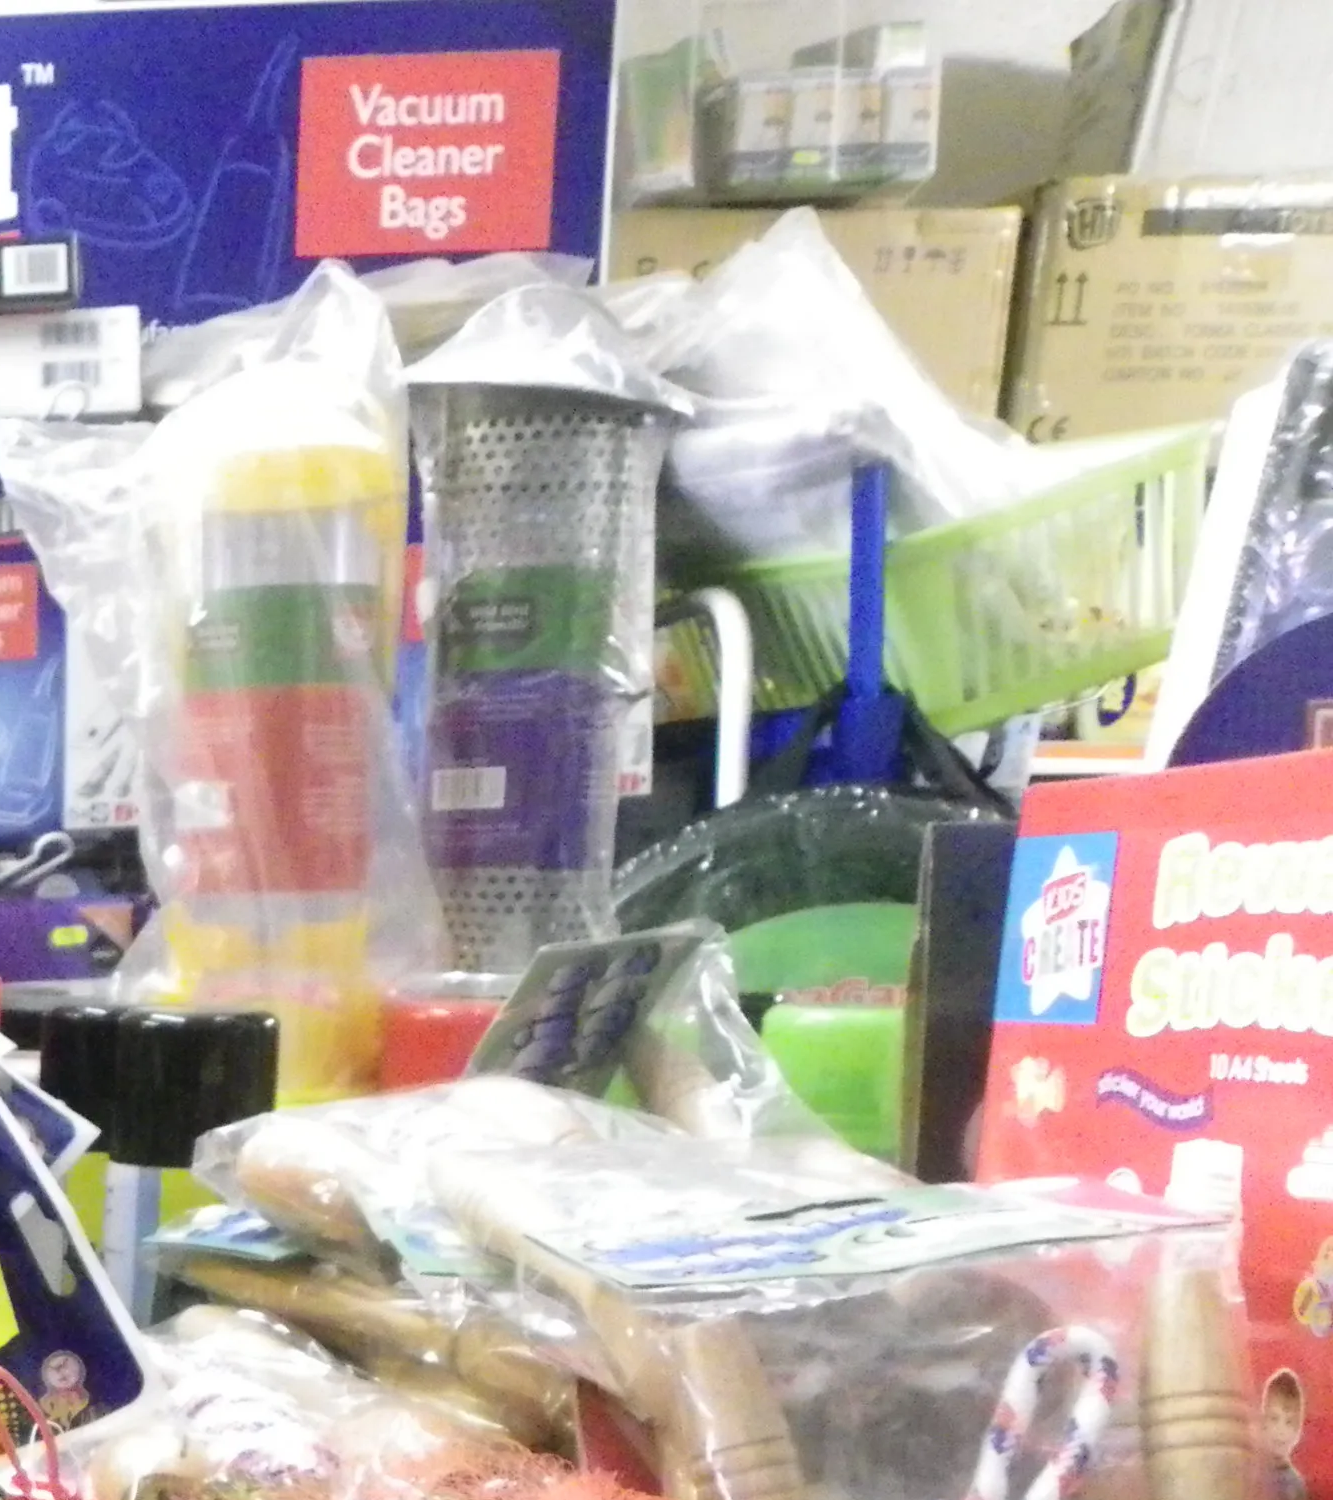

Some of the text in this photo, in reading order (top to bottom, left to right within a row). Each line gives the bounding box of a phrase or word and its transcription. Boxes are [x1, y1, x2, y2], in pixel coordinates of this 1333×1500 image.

[348, 83, 503, 126] Vacuum
[346, 133, 504, 178] Cleaner
[379, 185, 467, 240] Bags
